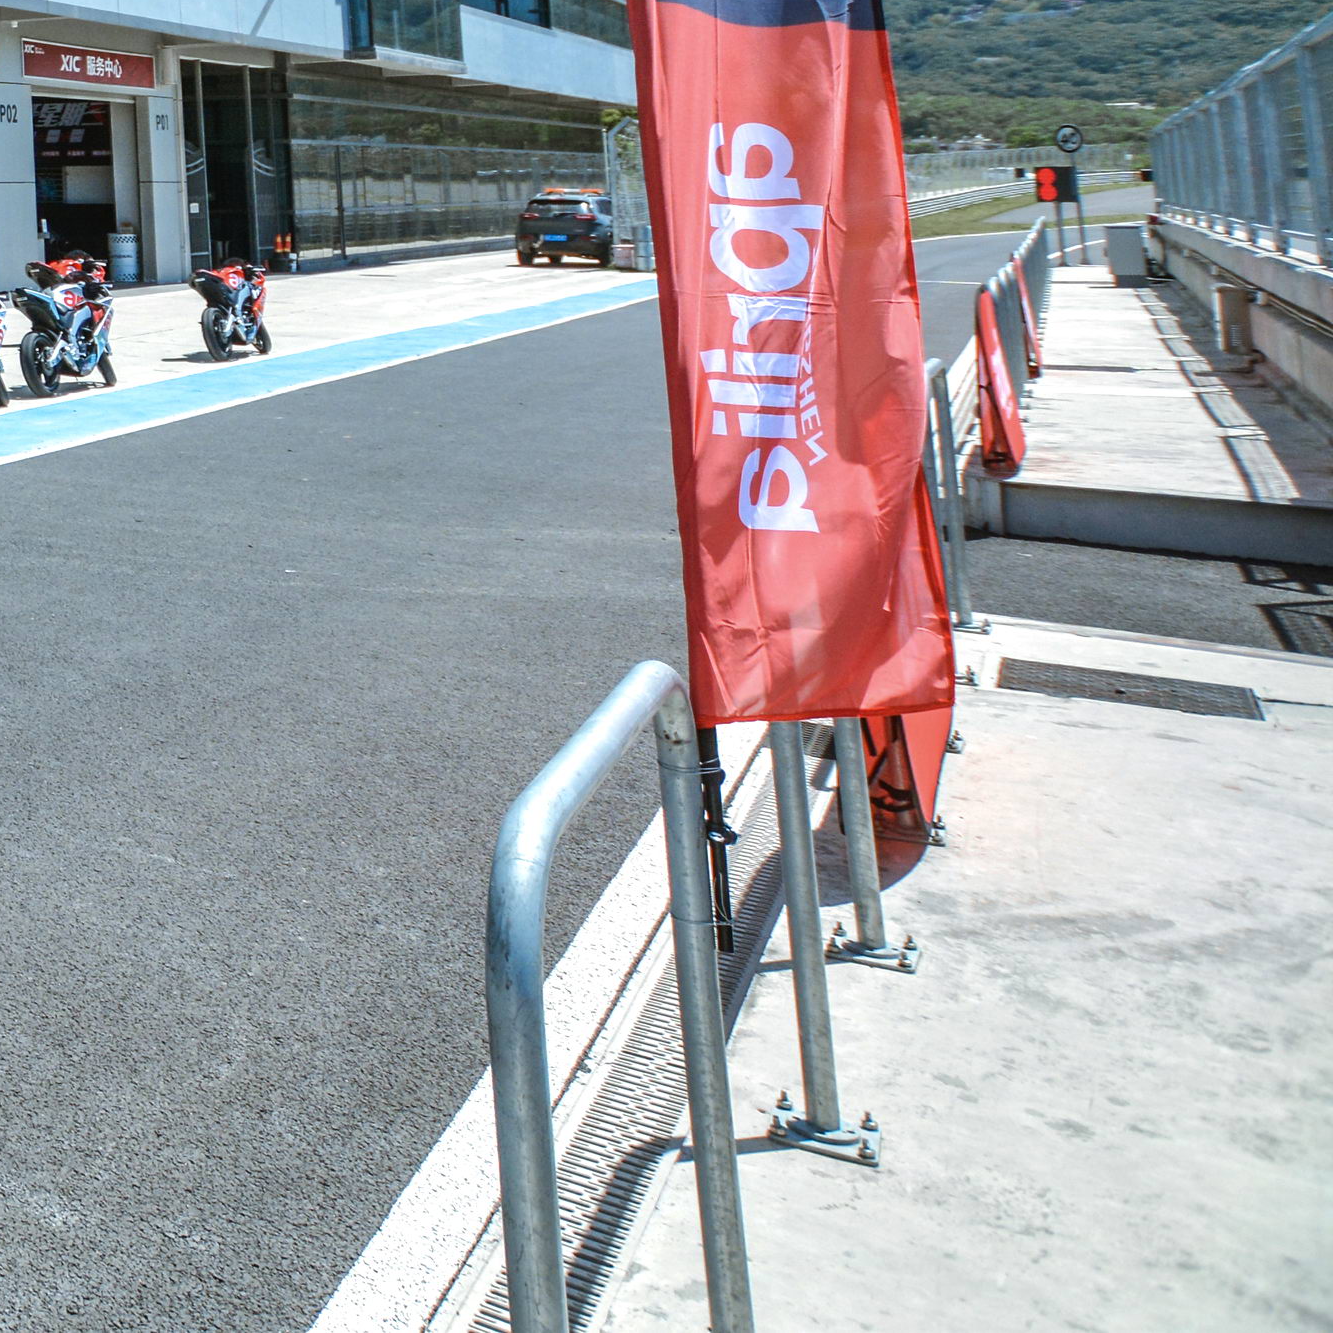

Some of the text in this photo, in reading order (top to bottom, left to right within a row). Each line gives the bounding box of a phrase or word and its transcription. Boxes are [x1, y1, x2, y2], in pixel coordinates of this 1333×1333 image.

[60, 55, 123, 78] XIC 服务中心
[0, 104, 18, 123] P02
[156, 114, 169, 130] P01
